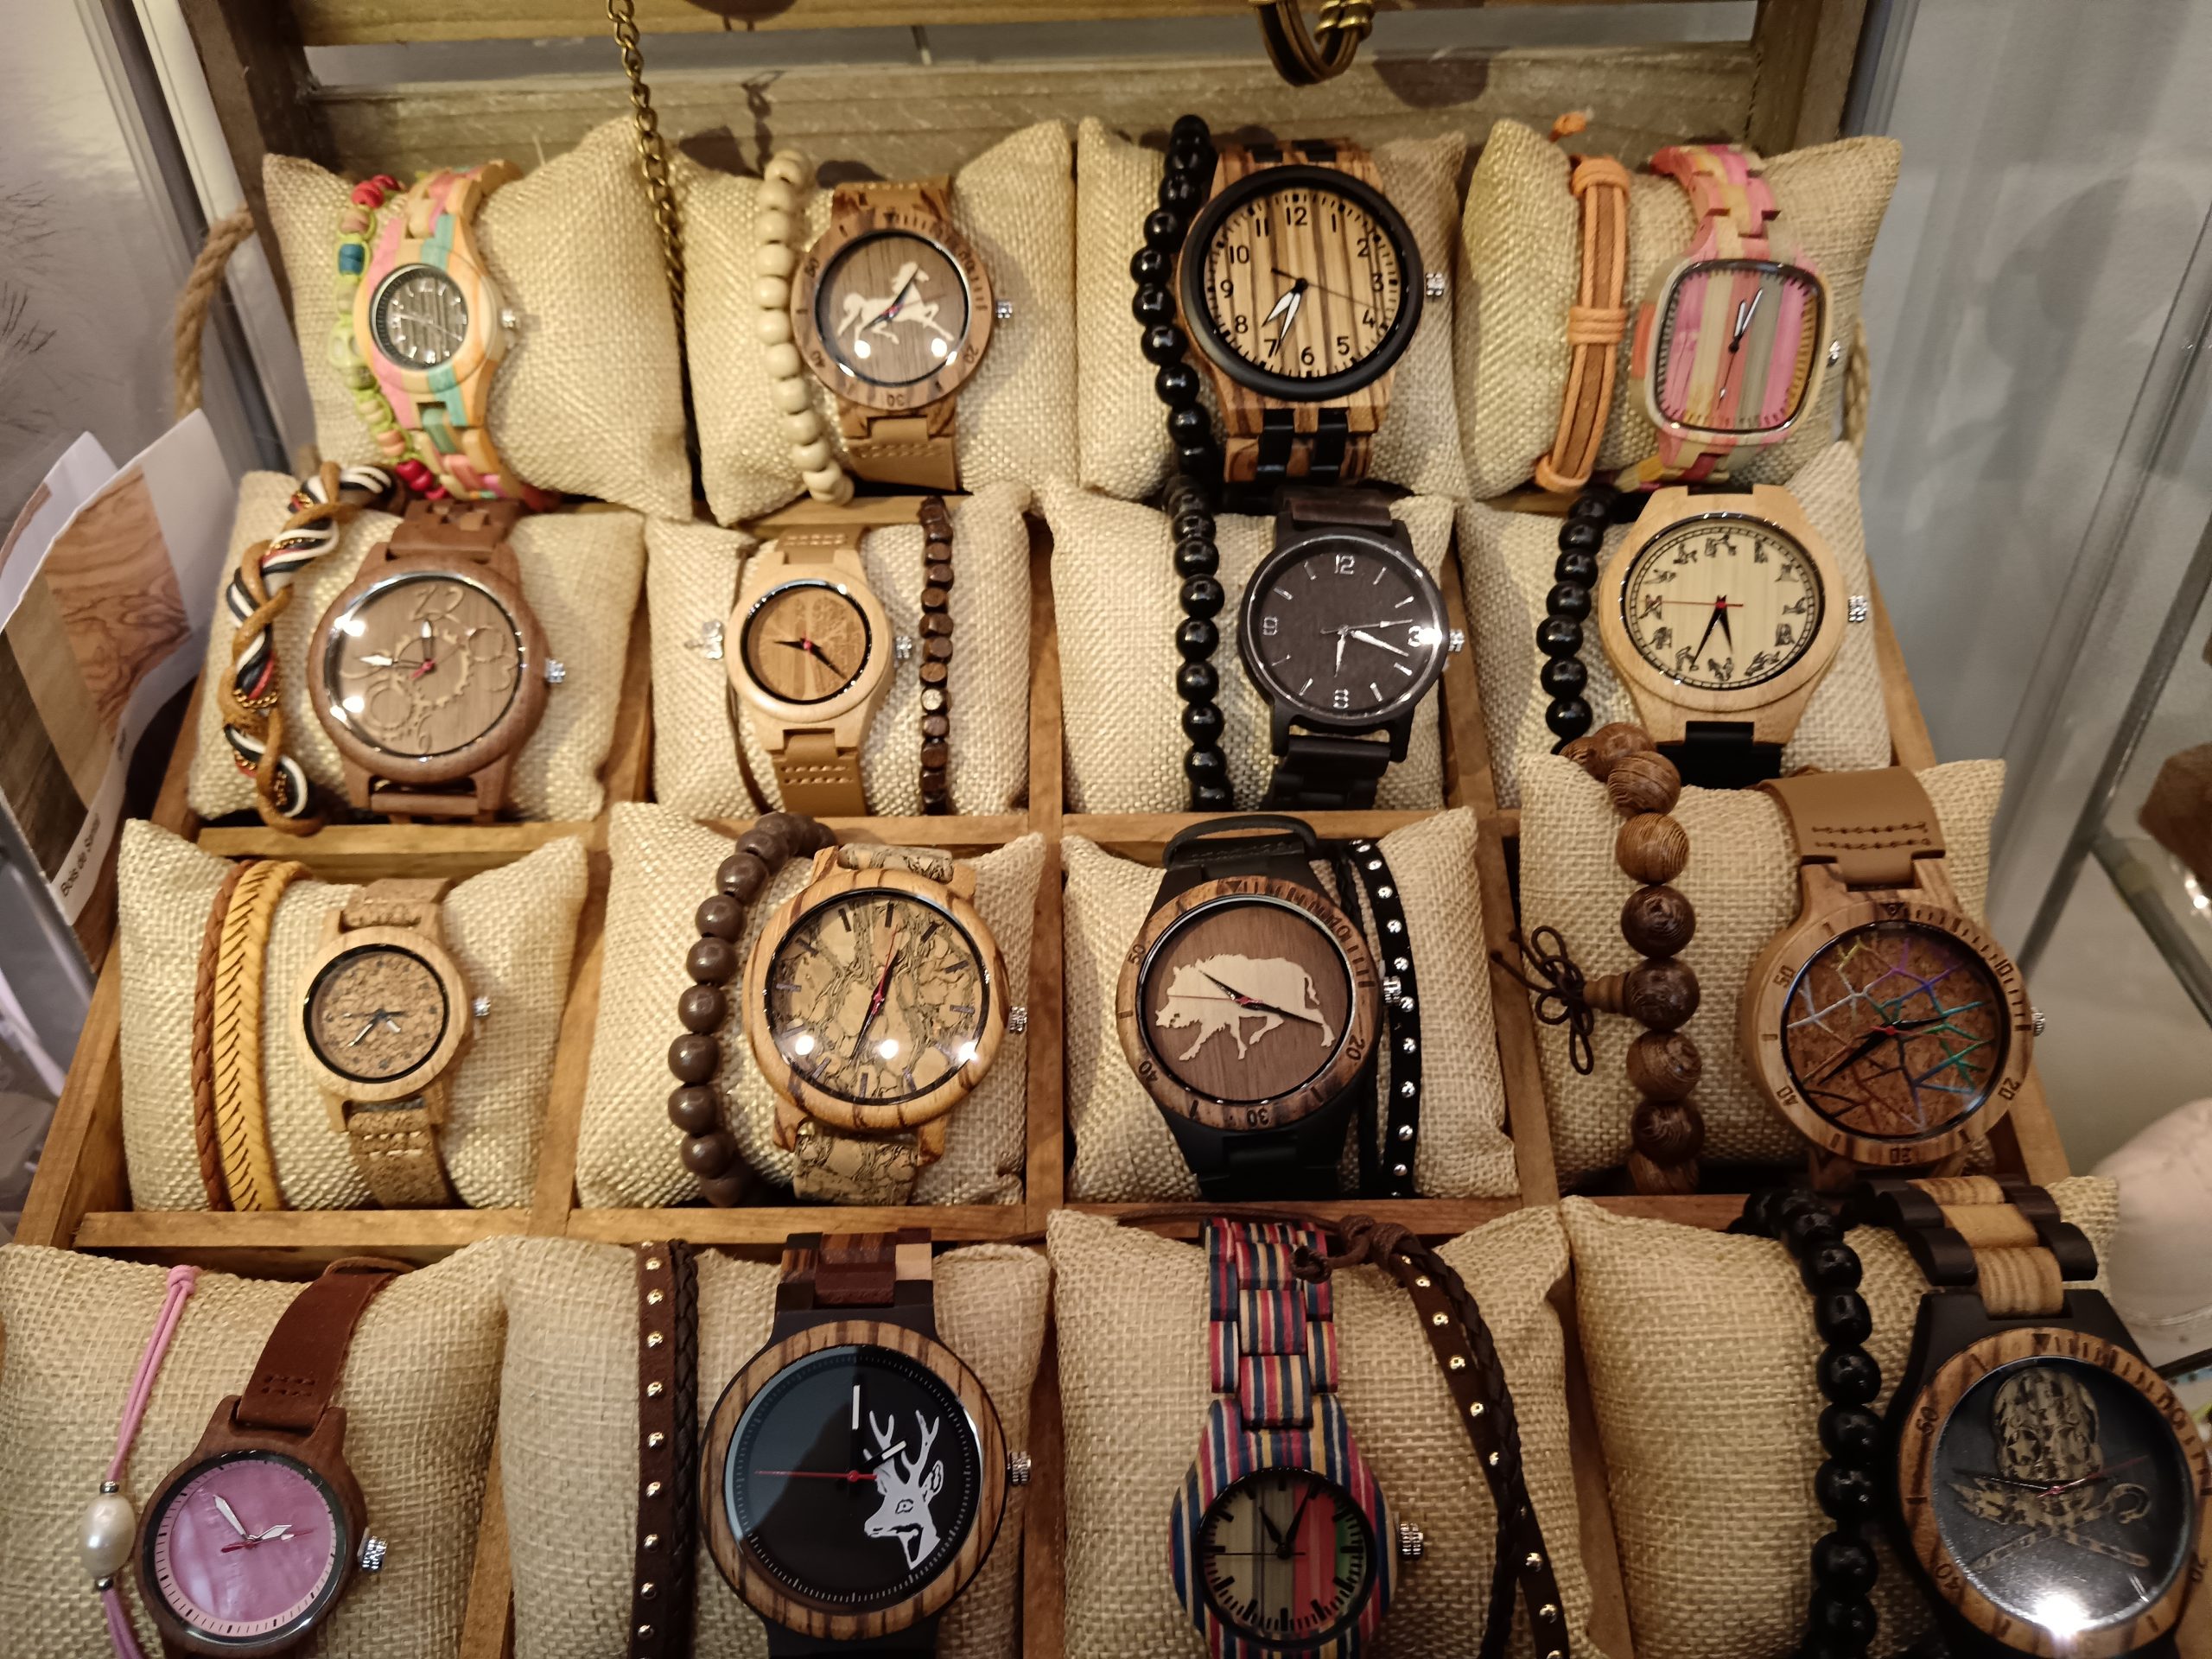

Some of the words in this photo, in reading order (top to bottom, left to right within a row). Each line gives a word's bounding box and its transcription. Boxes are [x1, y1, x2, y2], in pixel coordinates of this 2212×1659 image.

[1286, 207, 1307, 226] 12
[1332, 213, 1336, 232] 1
[1255, 219, 1269, 237] 11
[1229, 245, 1249, 264] 10
[1357, 239, 1370, 257] 2
[1220, 280, 1234, 298] 9
[1372, 273, 1383, 292] 3
[1235, 315, 1249, 334] 8
[1362, 309, 1376, 327] 4
[1264, 339, 1277, 358] 7
[1337, 336, 1350, 355] 5
[1301, 346, 1315, 365] 6
[887, 394, 905, 407] 30
[1334, 554, 1355, 575] 12
[60, 868, 79, 897] Bois
[1128, 944, 1146, 965] 50
[1774, 967, 1795, 988] 50
[1994, 959, 2014, 980] 10
[1346, 1034, 1365, 1061] 20
[1138, 1060, 1159, 1083] 40
[1777, 1085, 1798, 1107] 40
[1997, 1077, 2020, 1101] 20
[1246, 1108, 1269, 1127] 30
[1890, 1147, 1912, 1164] 30
[1935, 1563, 1961, 1592] 40
